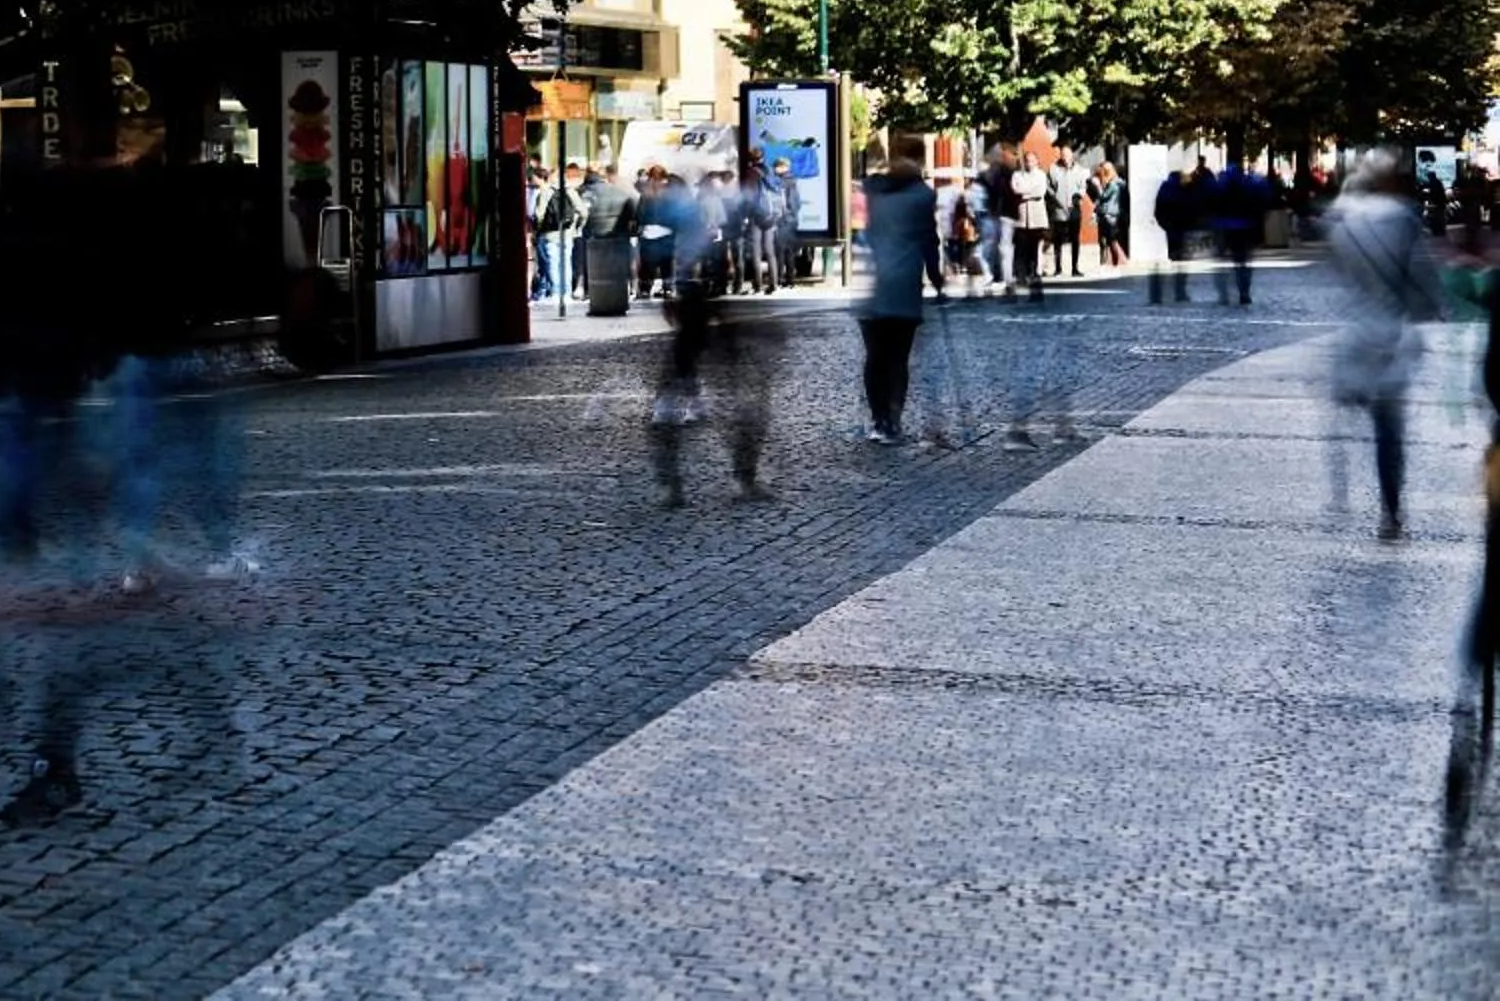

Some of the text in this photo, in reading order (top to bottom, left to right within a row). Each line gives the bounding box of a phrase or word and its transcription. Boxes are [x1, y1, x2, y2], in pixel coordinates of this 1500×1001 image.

[349, 56, 365, 149] FRESH
[756, 97, 784, 106] IKEA
[756, 106, 791, 116] POINT
[681, 132, 708, 151] GLS
